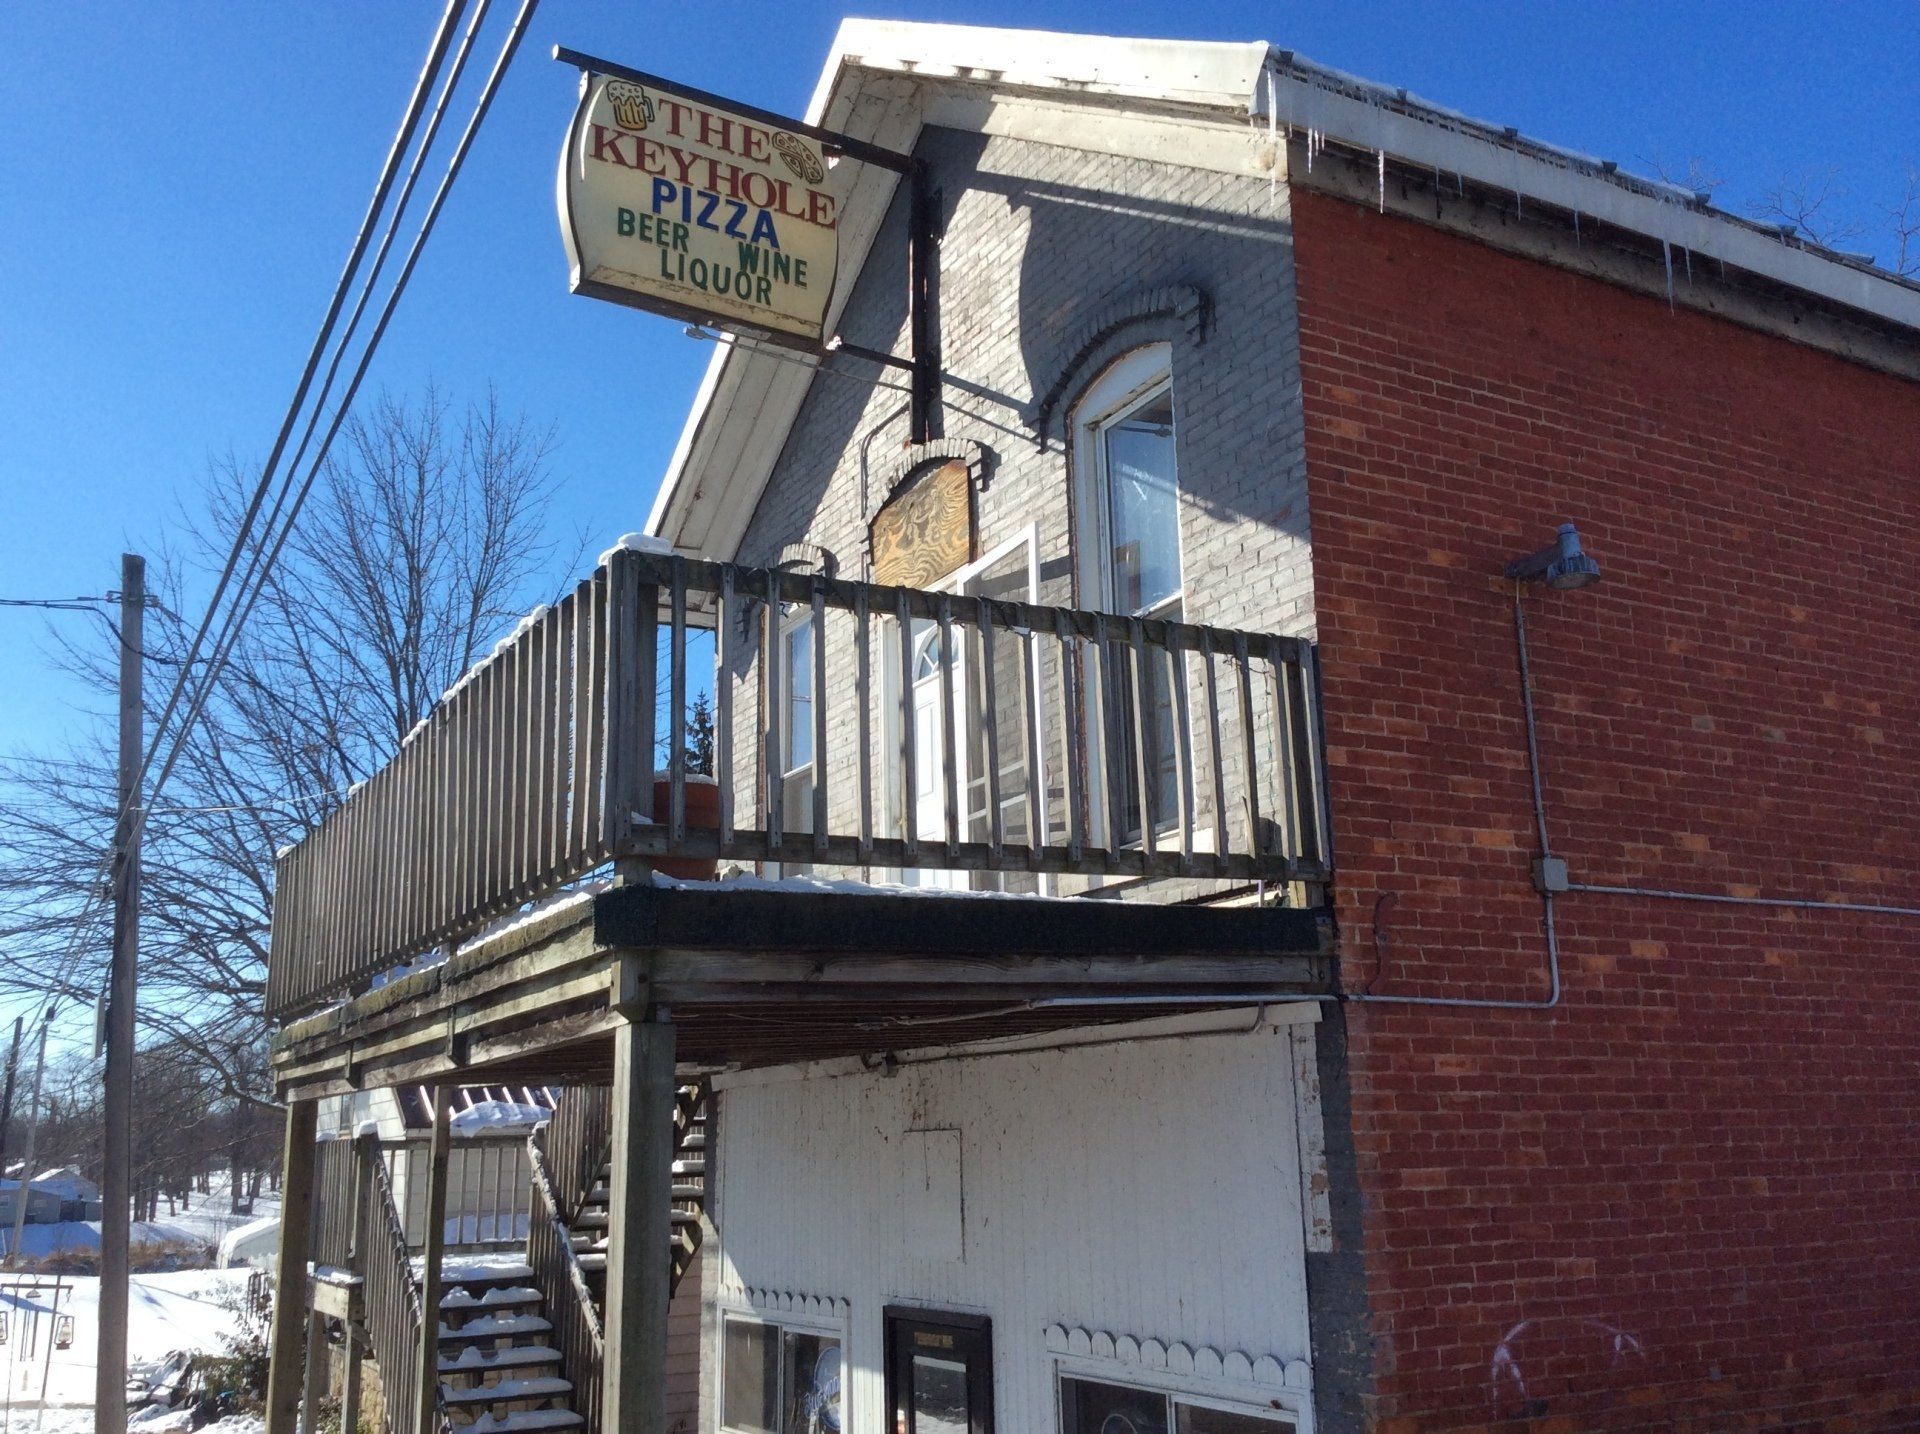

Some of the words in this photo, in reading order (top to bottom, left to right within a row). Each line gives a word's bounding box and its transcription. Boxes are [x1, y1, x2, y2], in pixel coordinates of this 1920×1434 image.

[658, 98, 771, 165] THE
[589, 123, 836, 230] KEYHOLE
[652, 176, 780, 249] PIZZA
[617, 207, 690, 253] BEER
[738, 241, 808, 289] WINE
[661, 249, 772, 306] LIQUOR
